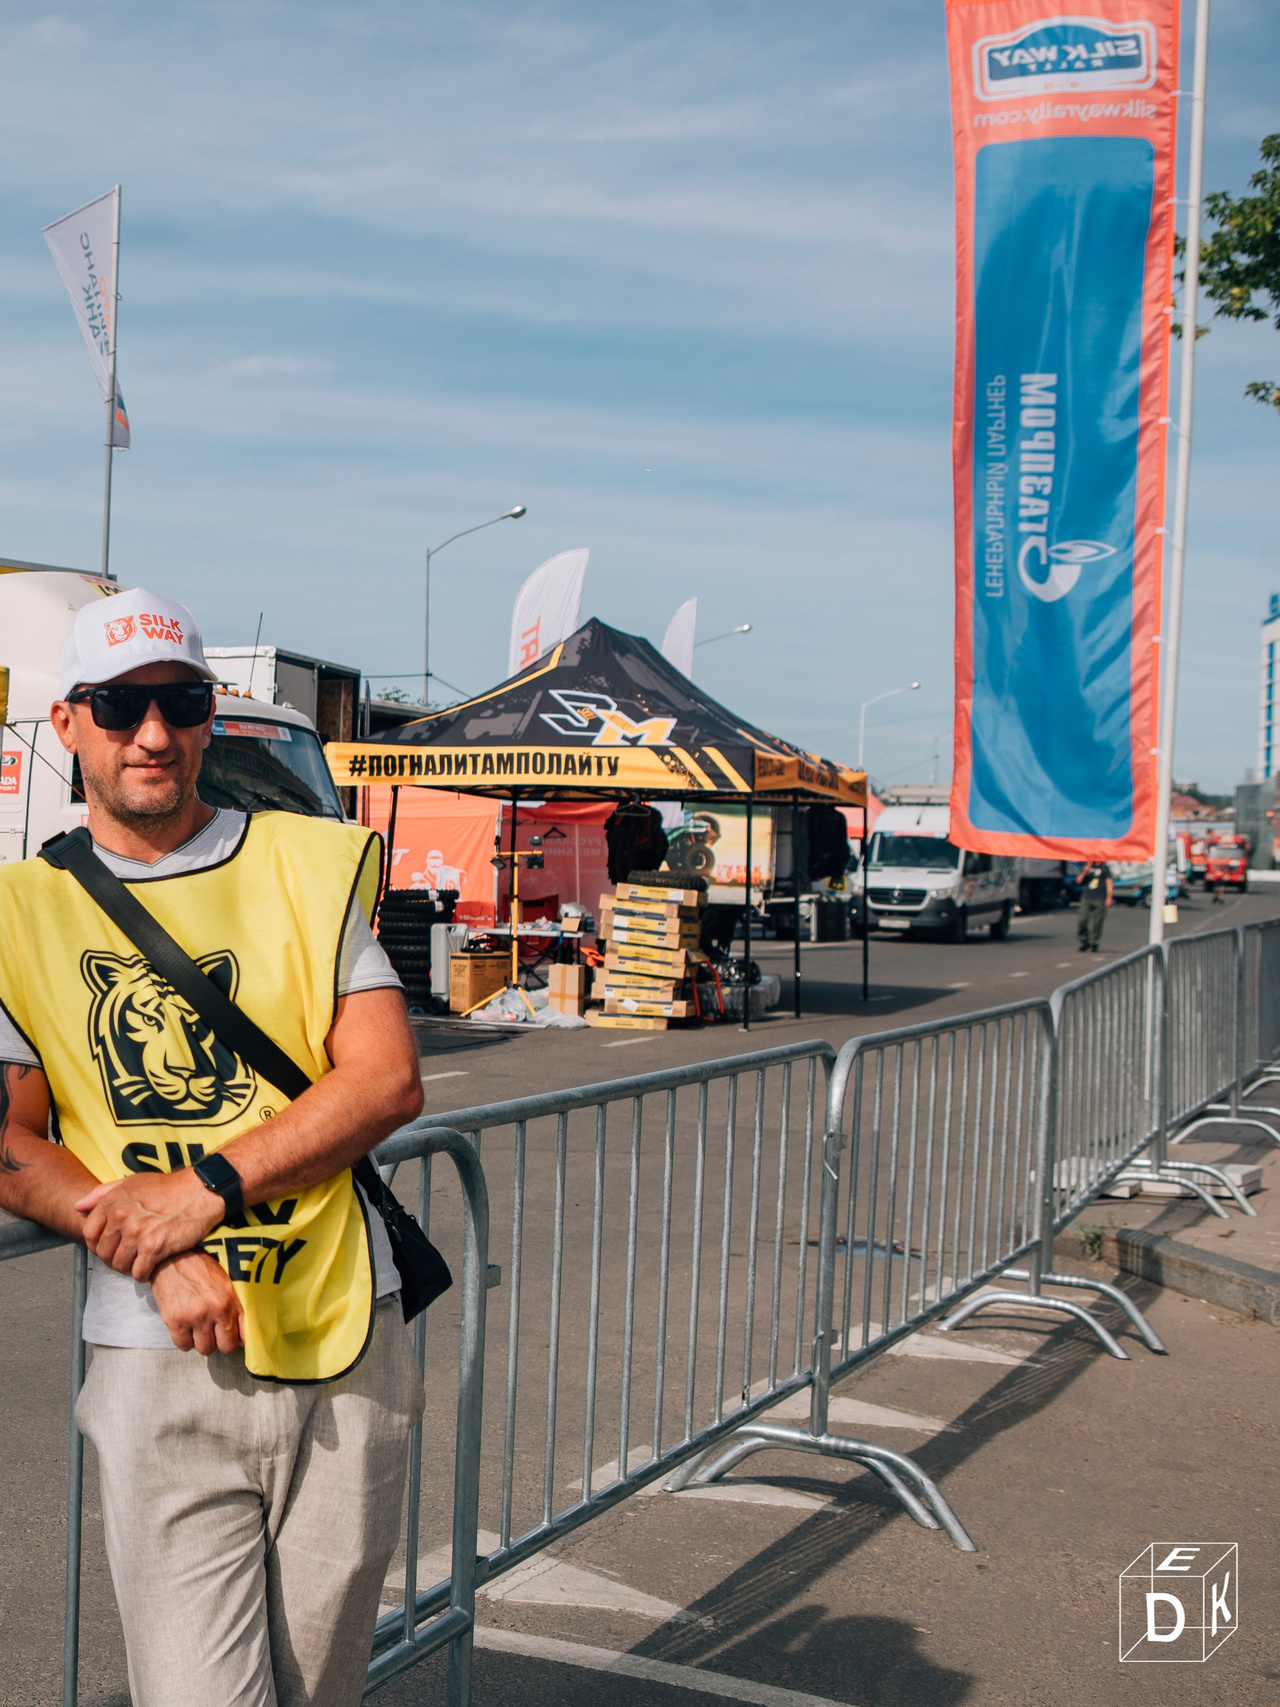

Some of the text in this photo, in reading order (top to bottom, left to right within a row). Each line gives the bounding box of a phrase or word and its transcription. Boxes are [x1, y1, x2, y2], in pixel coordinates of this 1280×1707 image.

[138, 613, 183, 635] SILK
[141, 627, 184, 646] WAY
[349, 752, 619, 777] #ПОГНАЛИТАМПОЛАЙТУ
[0, 776, 18, 786] ADA
